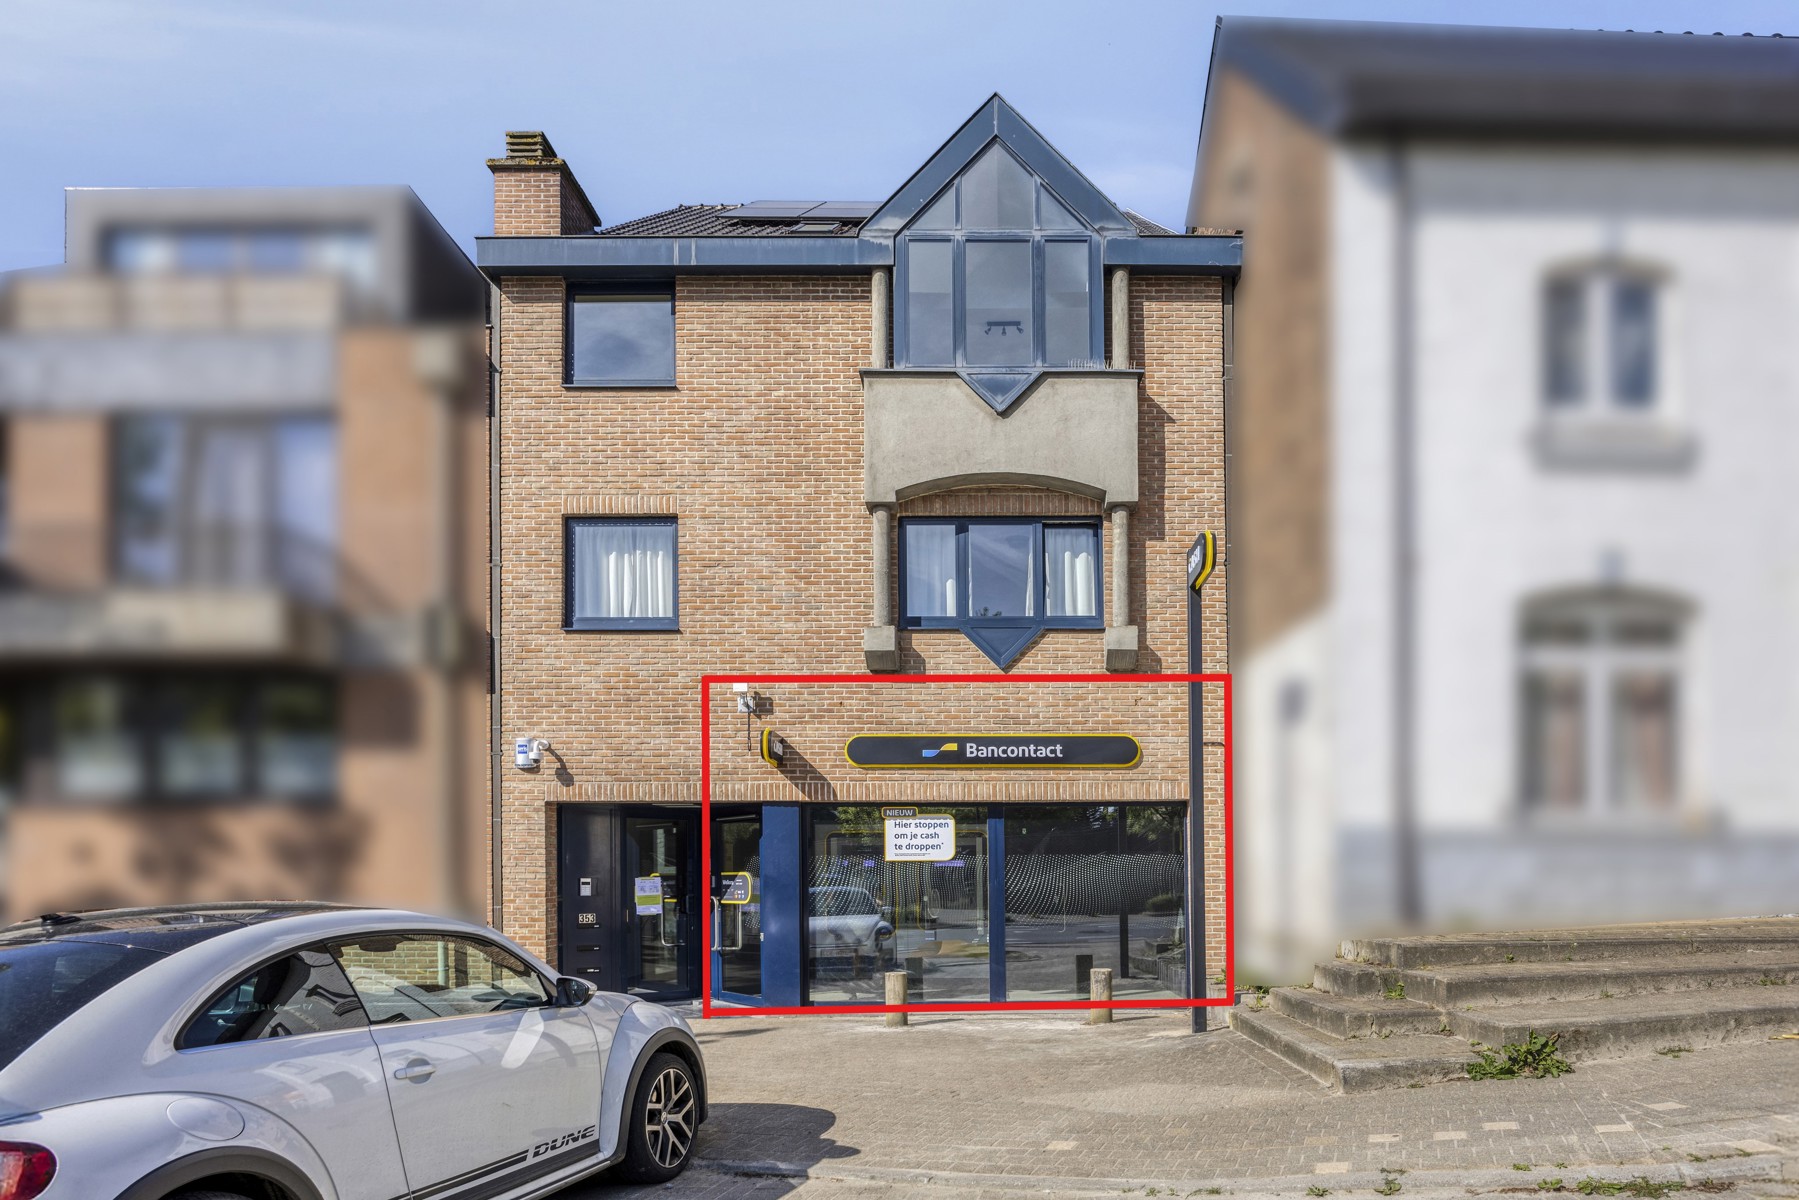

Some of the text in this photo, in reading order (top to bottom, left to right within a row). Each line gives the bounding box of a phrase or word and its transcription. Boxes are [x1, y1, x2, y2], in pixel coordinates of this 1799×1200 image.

[966, 742, 1063, 758] Bancontact
[914, 821, 949, 830] stoppen
[910, 832, 918, 840] je
[579, 913, 595, 923] 353
[532, 1125, 596, 1158] DUNE
